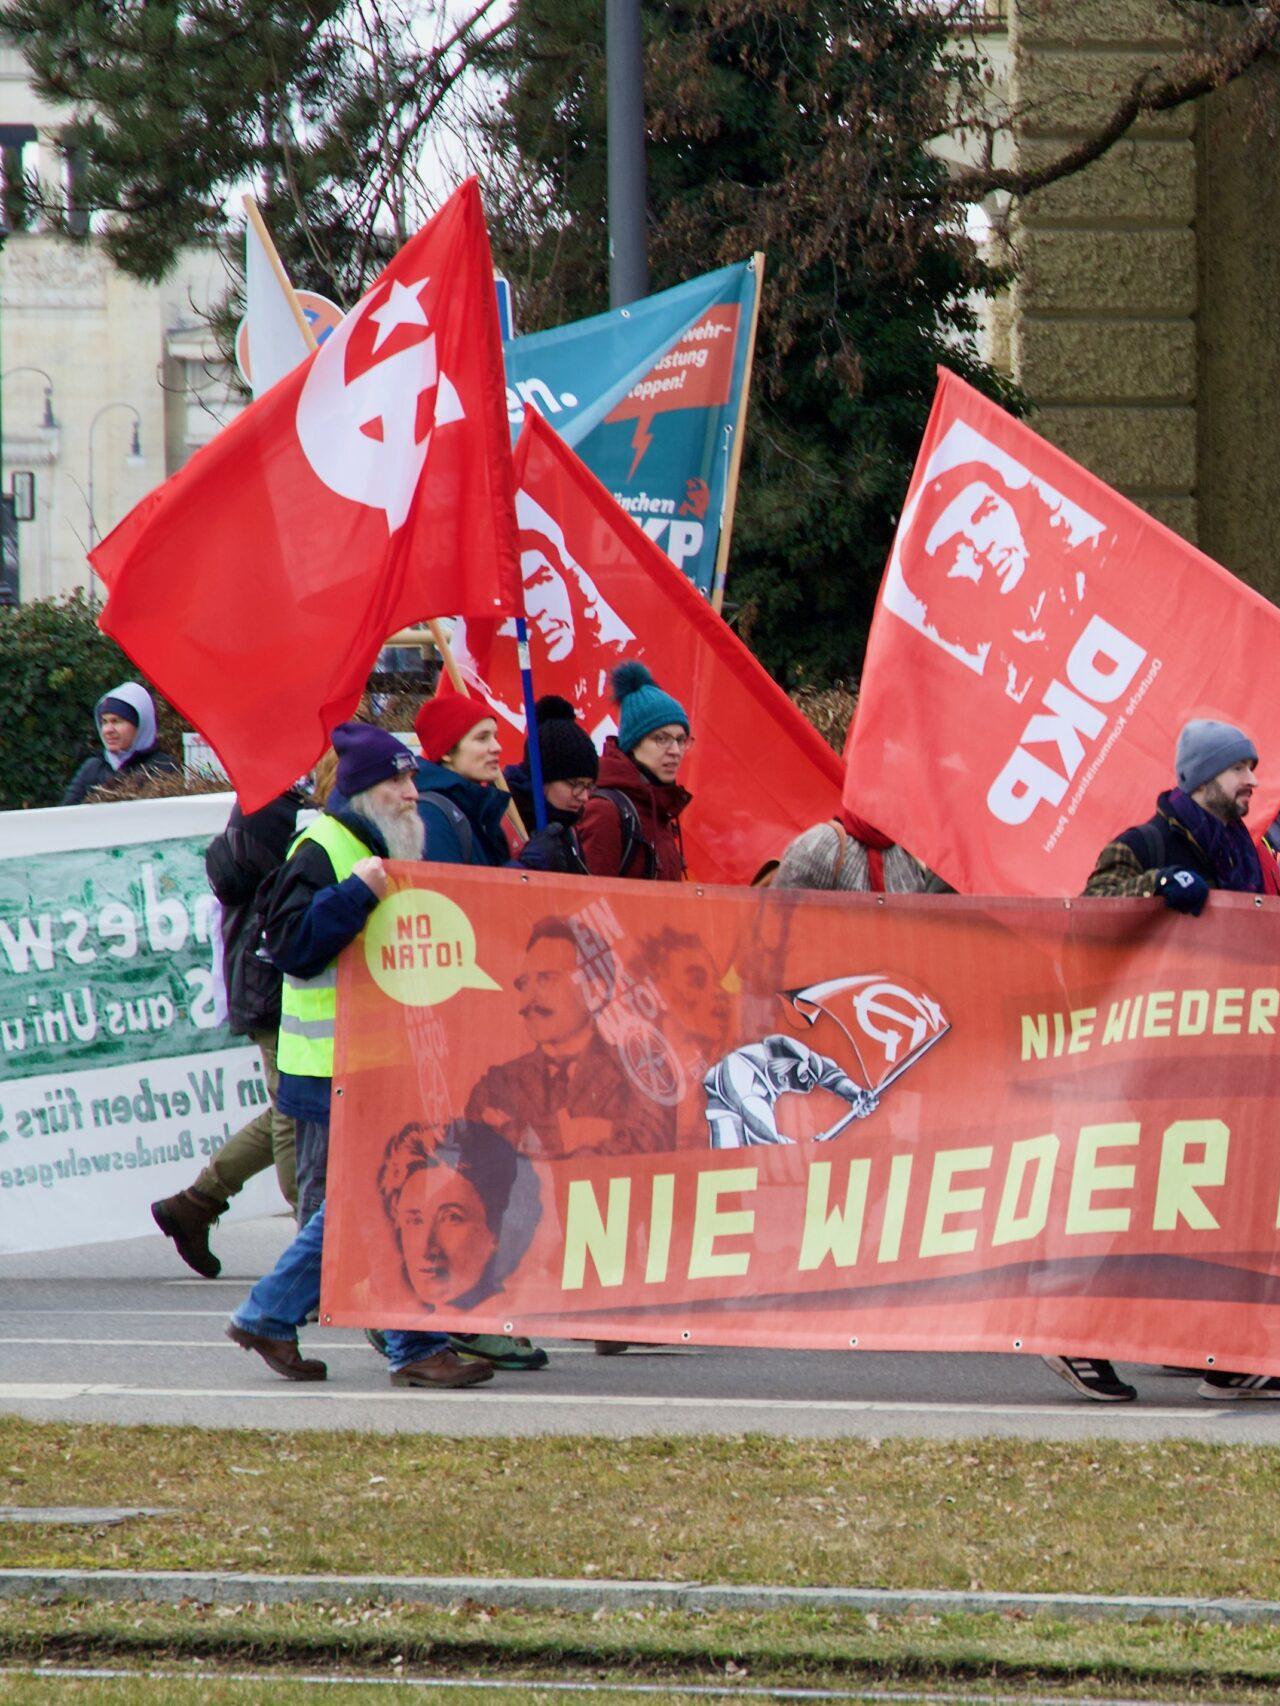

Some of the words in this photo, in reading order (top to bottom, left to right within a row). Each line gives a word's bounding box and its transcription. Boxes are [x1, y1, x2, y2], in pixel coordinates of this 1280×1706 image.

[396, 913, 432, 940] NO
[380, 940, 465, 970] NATO!
[1021, 1007, 1098, 1062] NIE
[1101, 987, 1280, 1043] WIEDER
[561, 1166, 759, 1291] NIE
[797, 1118, 1231, 1272] WIEDER
